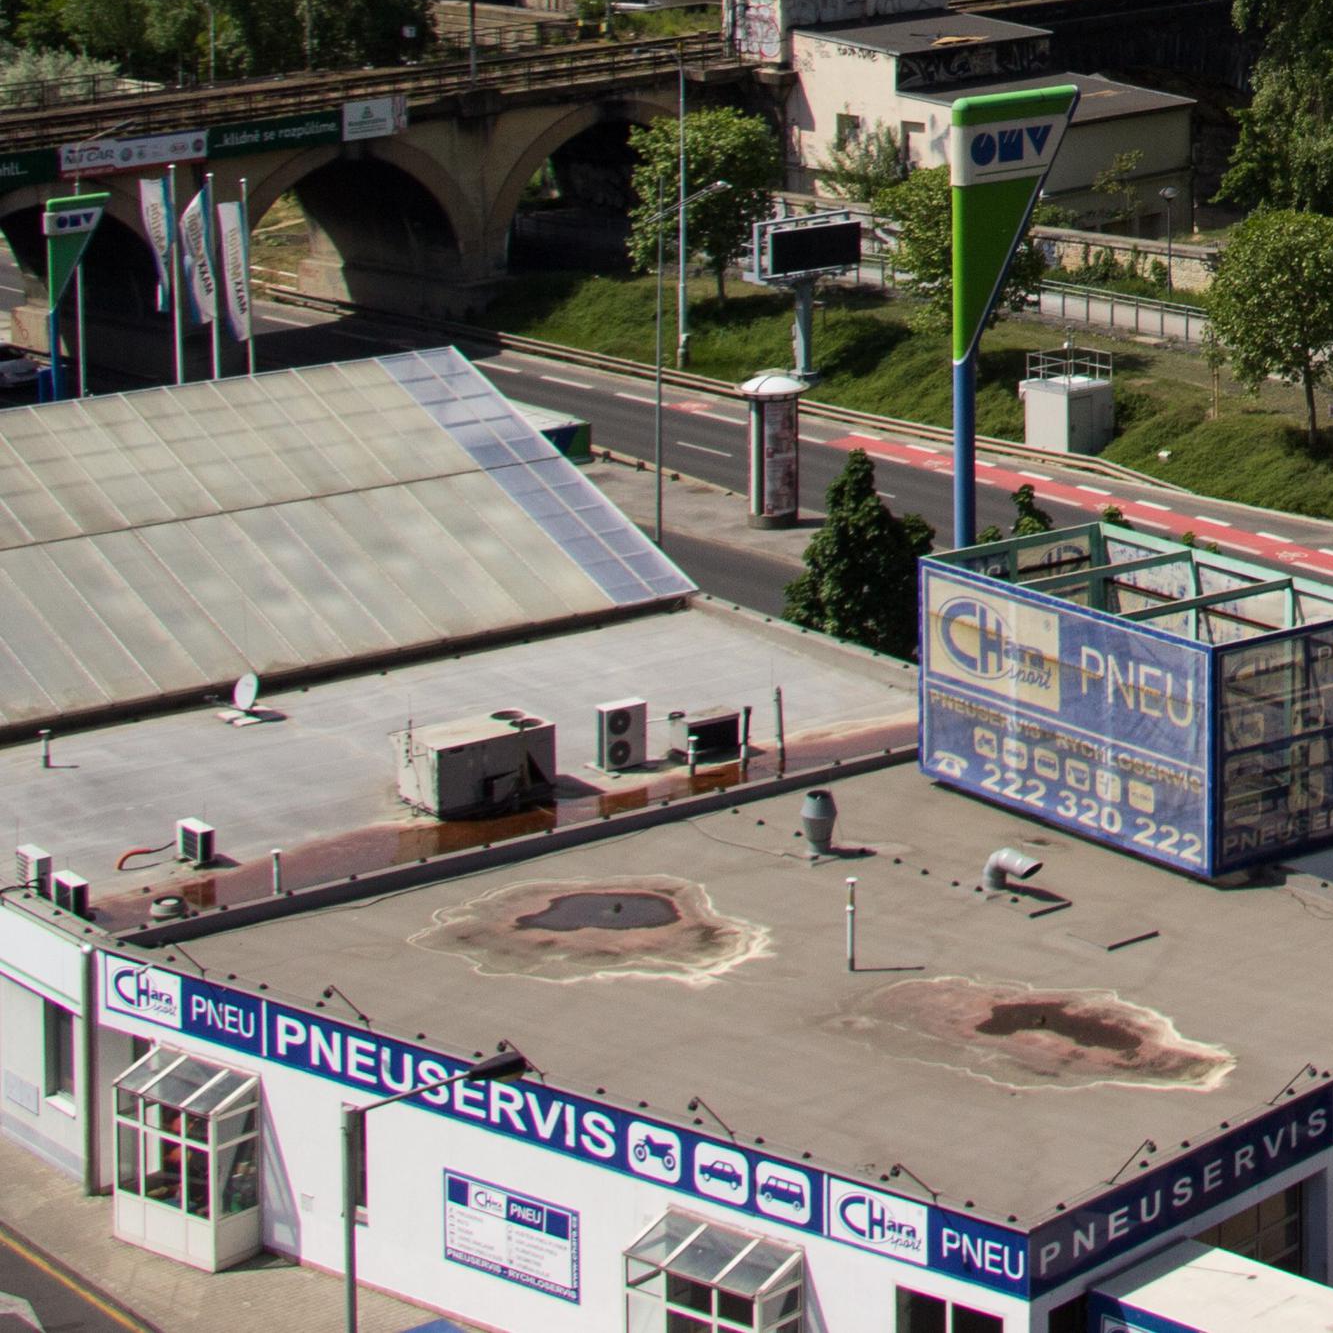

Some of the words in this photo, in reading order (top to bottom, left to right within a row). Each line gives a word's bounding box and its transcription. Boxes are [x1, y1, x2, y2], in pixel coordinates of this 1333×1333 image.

[263, 129, 275, 141] se
[970, 124, 1053, 166] OMV
[56, 212, 95, 229] OMV
[1007, 665, 1052, 690] sport
[1081, 645, 1194, 728] PNEU
[980, 762, 1047, 809] 222
[1056, 789, 1123, 835] 320
[1132, 816, 1203, 864] 222
[190, 993, 255, 1039] PNEU
[276, 1013, 617, 1160] PNEUSERVIS
[510, 1202, 542, 1225] PNEU
[1039, 1107, 1328, 1277] PNEUSERVIS
[940, 1226, 1025, 1281] PNEU
